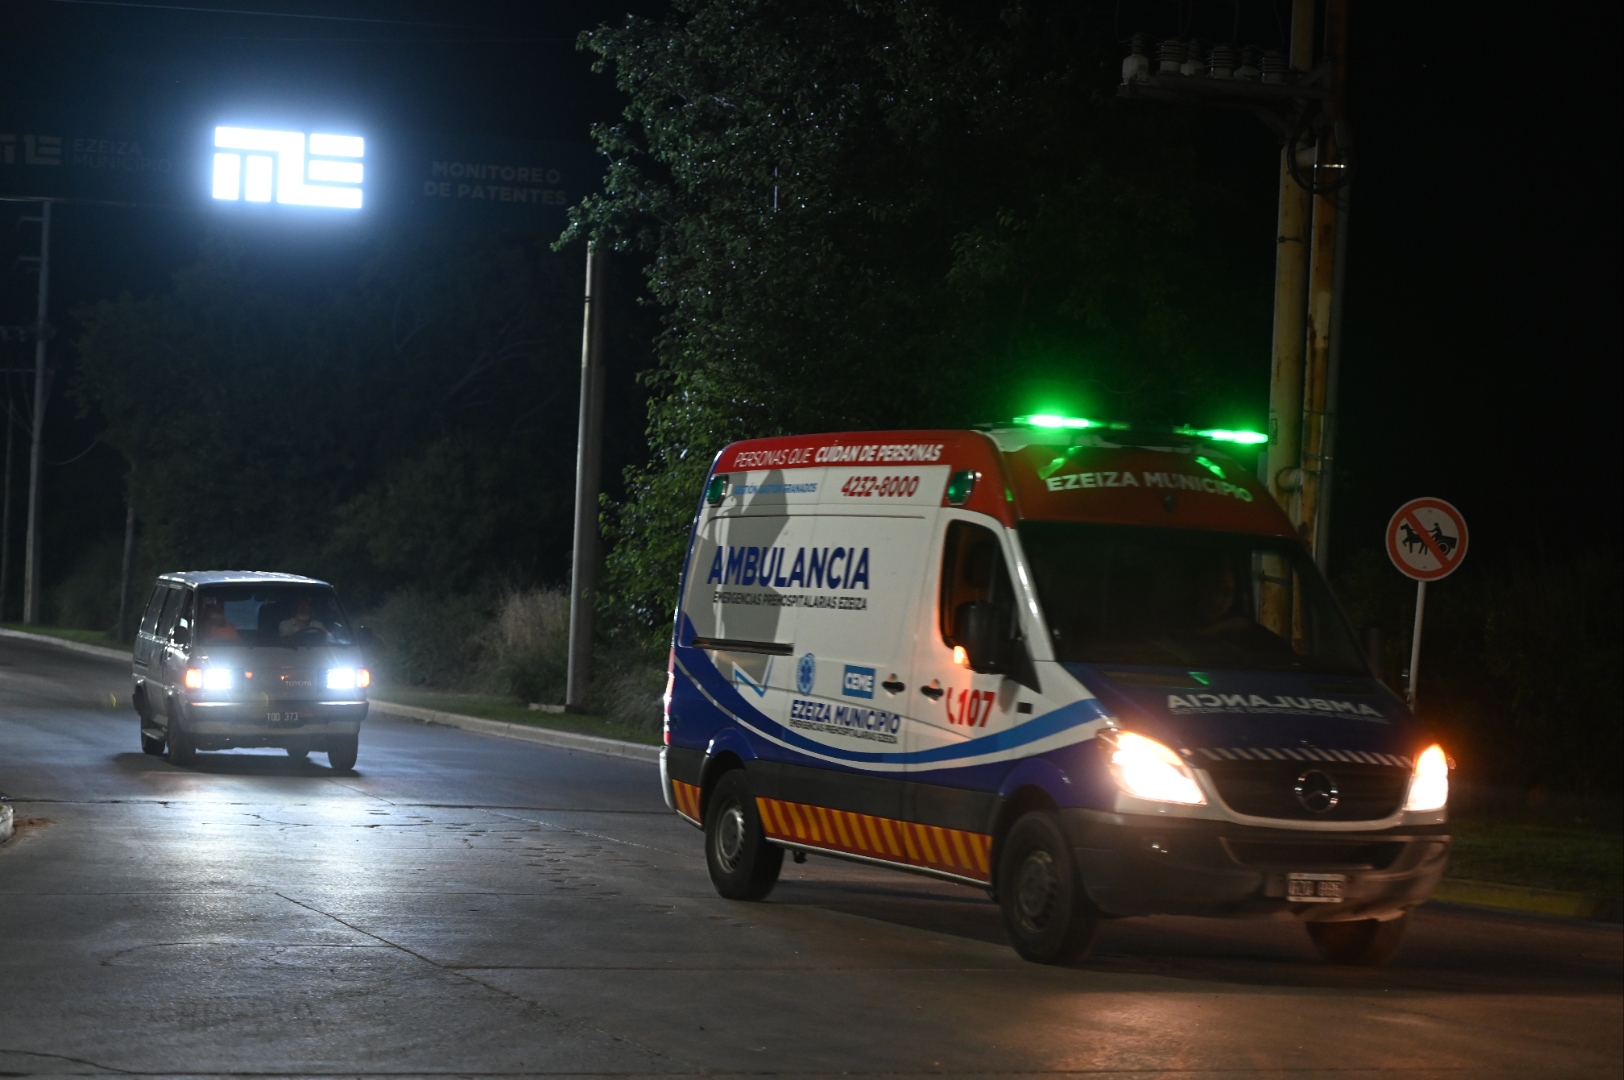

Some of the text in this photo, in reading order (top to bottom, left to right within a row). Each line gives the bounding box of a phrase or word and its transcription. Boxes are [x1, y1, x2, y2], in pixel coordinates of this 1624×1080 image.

[73, 138, 141, 155] EZEIZA
[73, 153, 172, 172] MUNICIPIO
[423, 181, 567, 205] DE PATENTES
[733, 450, 789, 467] PERSONAS
[789, 447, 814, 464] QUE
[858, 445, 879, 462] DE
[875, 444, 944, 461] PERSONAS
[1045, 471, 1253, 502] EZEIZA MUNICIPIO
[706, 546, 869, 590] AMBULANCIA
[713, 591, 762, 606] EMERGENCIAS
[838, 596, 868, 610] EZEIZA
[790, 700, 900, 734] EZEIZA MUNICIPIO
[957, 689, 996, 727] 107
